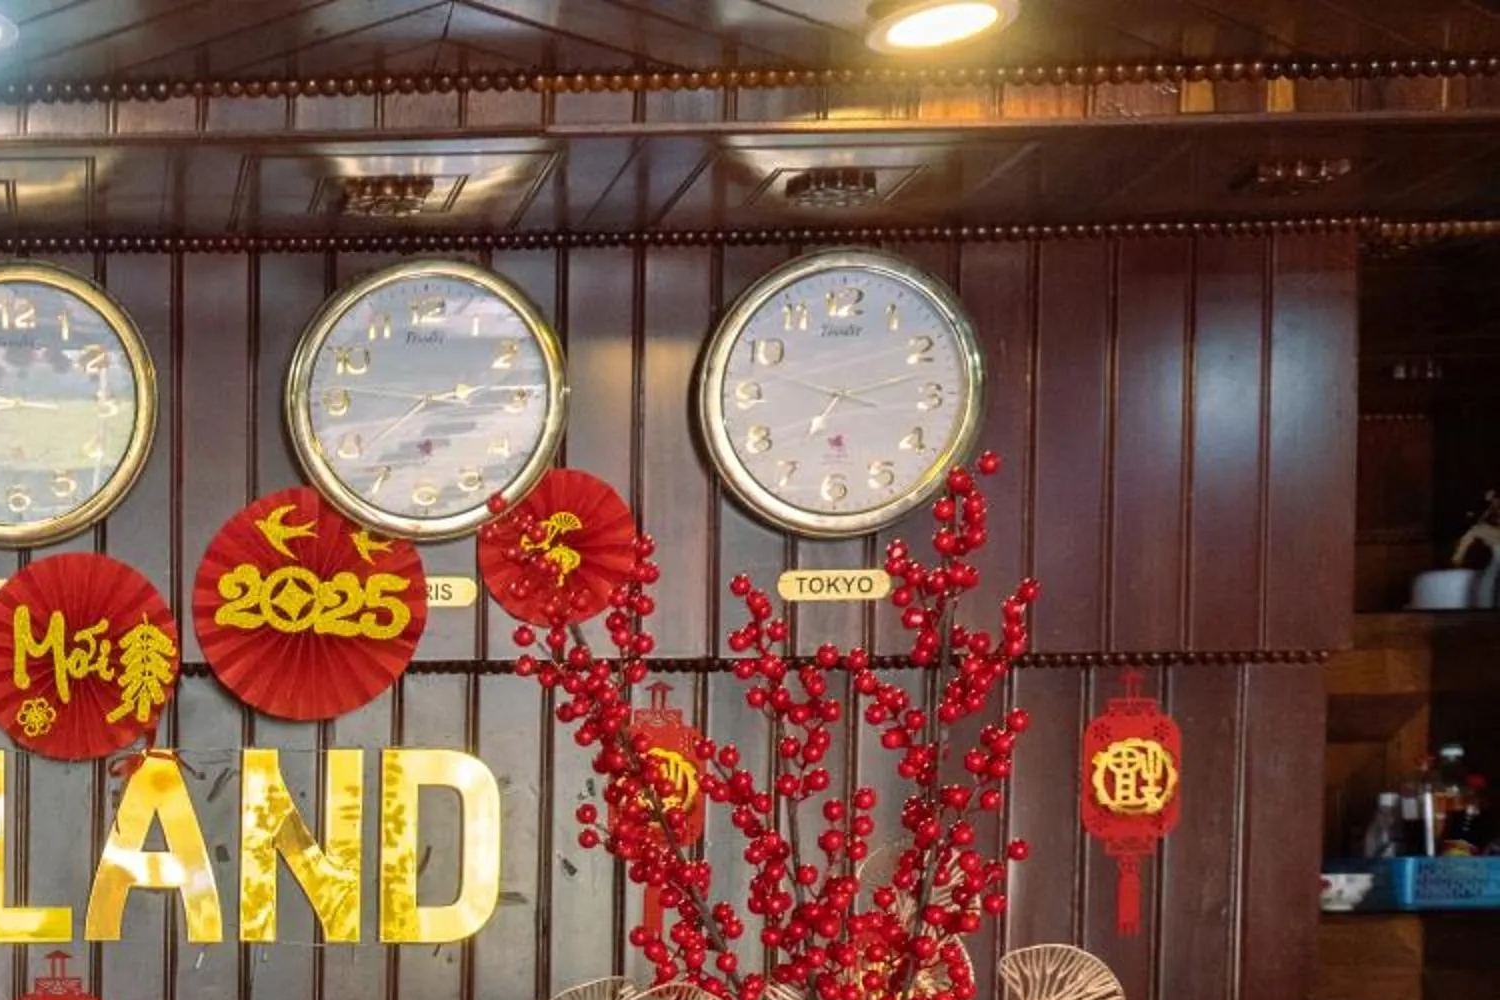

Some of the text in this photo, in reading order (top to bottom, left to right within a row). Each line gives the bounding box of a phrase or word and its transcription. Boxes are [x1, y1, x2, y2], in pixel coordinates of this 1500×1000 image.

[826, 287, 864, 317] 12
[782, 303, 808, 331] 11
[885, 303, 898, 331] 1
[750, 338, 784, 367] 10
[907, 335, 934, 365] 2
[735, 381, 762, 410] 9
[917, 382, 943, 410] 3
[746, 425, 773, 454] 8
[899, 427, 924, 452] 4
[778, 460, 798, 486] 7
[820, 473, 847, 502] 6
[868, 460, 894, 489] 5
[426, 584, 453, 601] RIS
[795, 576, 874, 594] TOKYO
[214, 563, 411, 640] 2025
[13, 605, 114, 705] Mới
